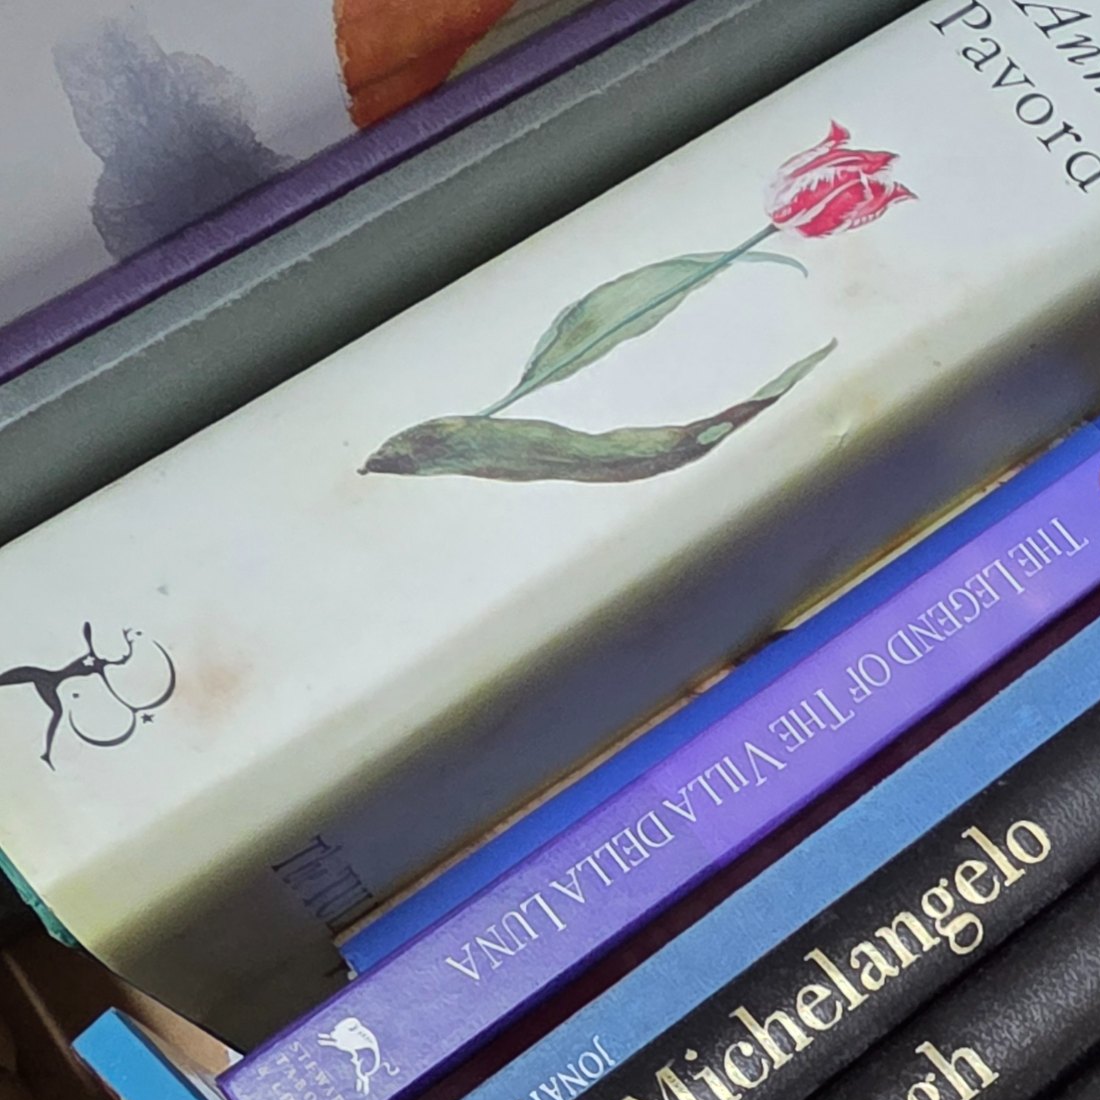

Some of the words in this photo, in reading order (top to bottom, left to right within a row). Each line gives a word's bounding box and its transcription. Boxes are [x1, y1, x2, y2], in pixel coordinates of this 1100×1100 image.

[1008, 517, 1089, 578] THE
[887, 558, 1024, 665] LEGEND
[845, 651, 892, 703] OF
[768, 686, 855, 752] THE
[662, 740, 787, 820] VILLA
[548, 811, 675, 905] DELLA
[445, 892, 567, 982] LUNA
